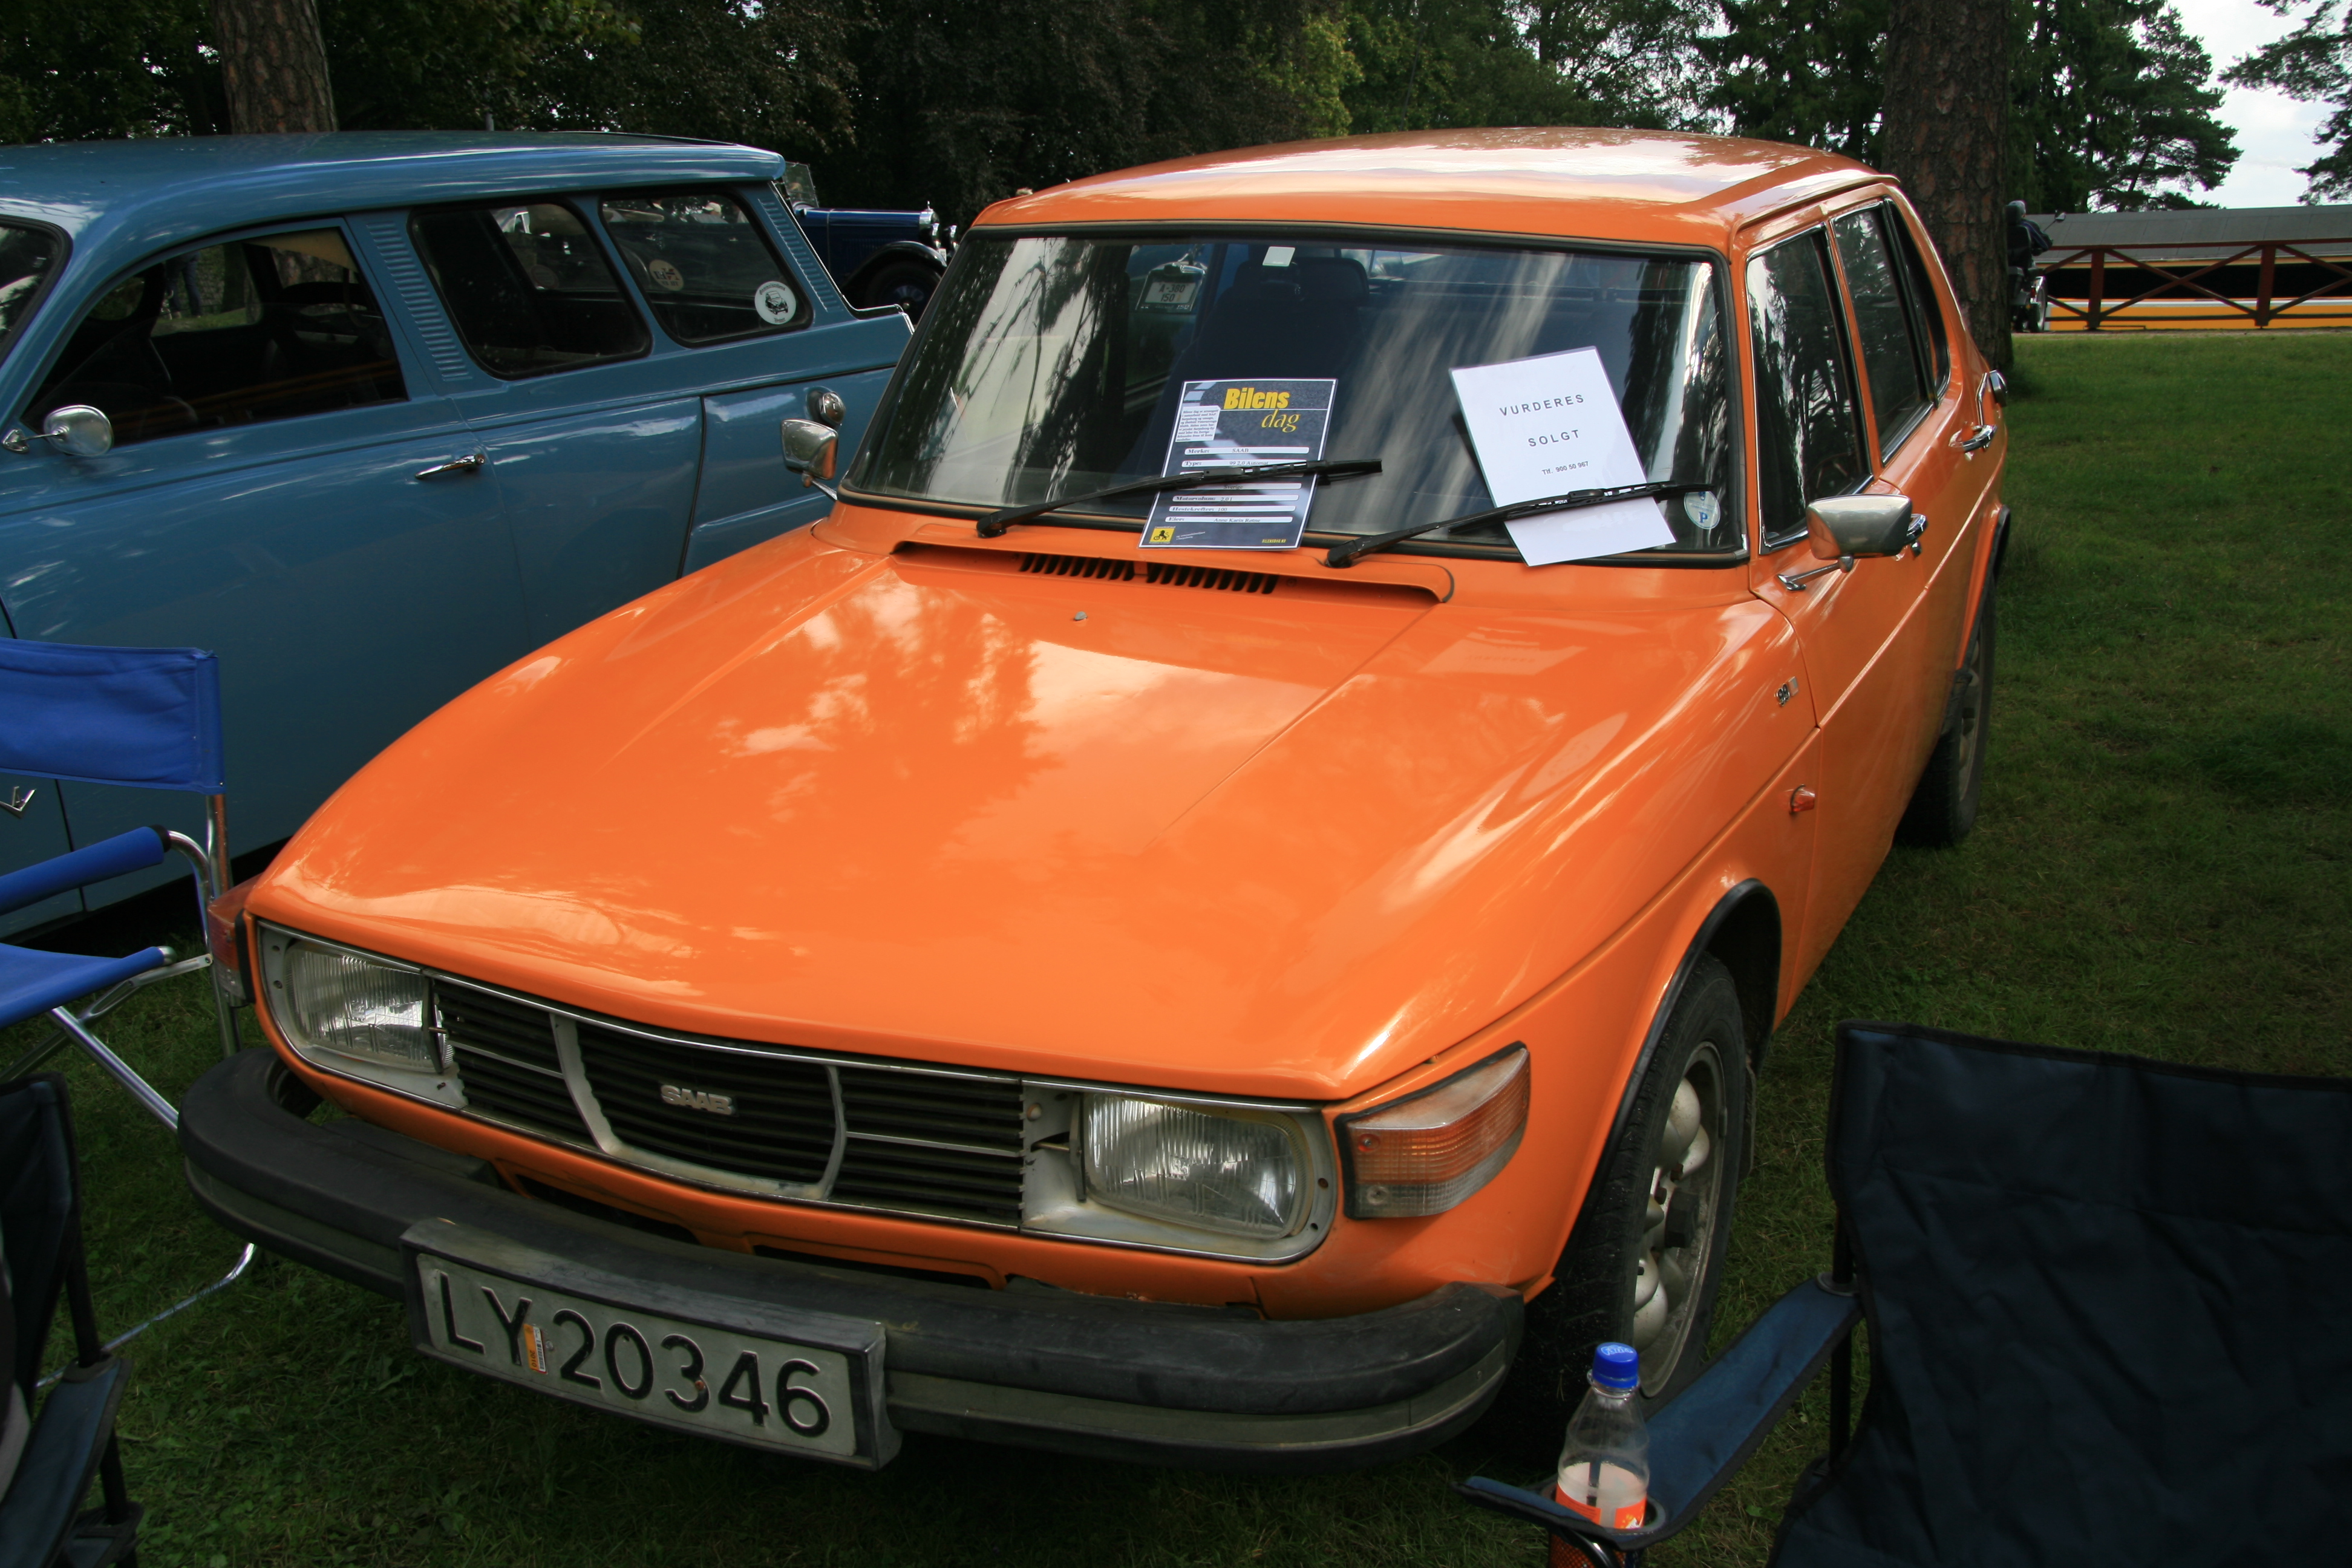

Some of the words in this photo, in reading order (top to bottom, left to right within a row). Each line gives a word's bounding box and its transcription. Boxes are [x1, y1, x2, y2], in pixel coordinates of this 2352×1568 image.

[1159, 284, 1186, 293] A-380
[1161, 293, 1175, 302] 150
[1223, 387, 1290, 410] Bilens
[1499, 394, 1584, 416] VURDERES
[1261, 410, 1301, 433] dag
[1527, 430, 1581, 447] SOLGT
[661, 1084, 736, 1116] SAAB
[440, 1271, 533, 1367] LY
[553, 1308, 831, 1439] 20346
